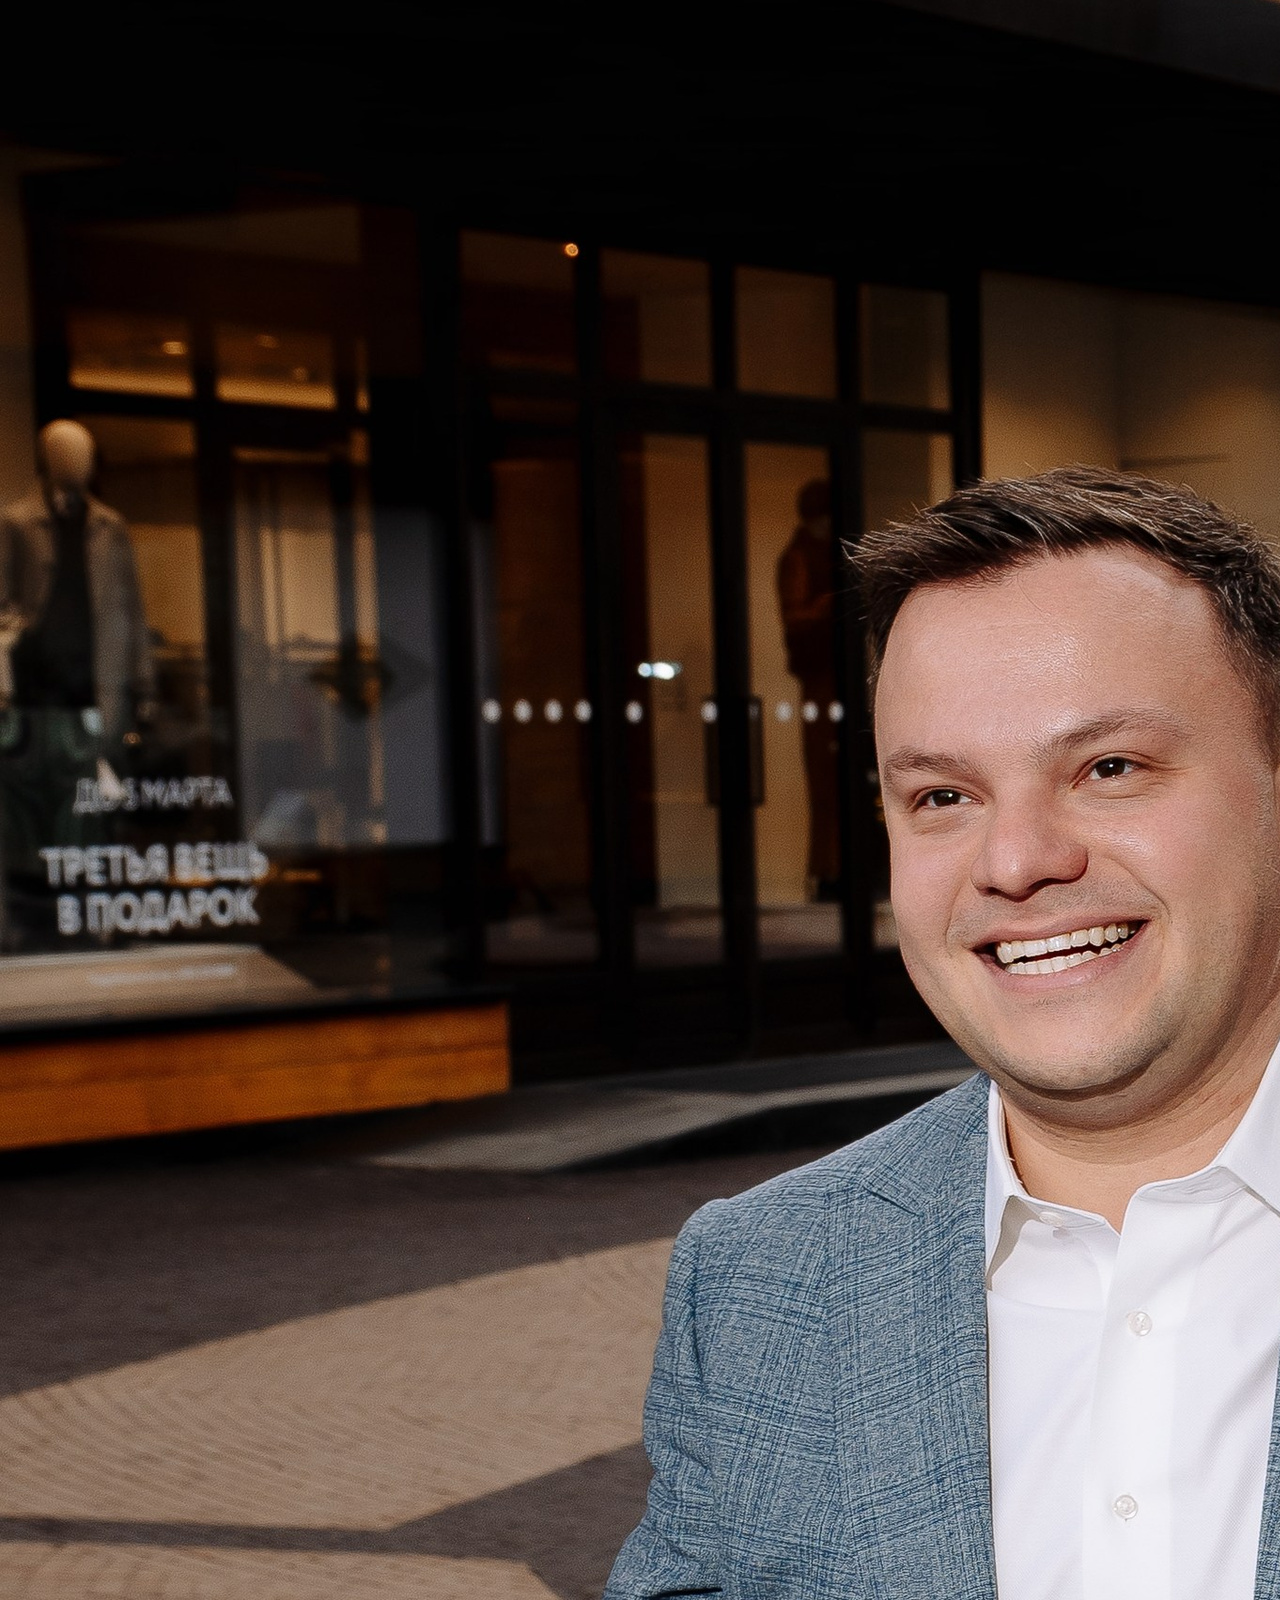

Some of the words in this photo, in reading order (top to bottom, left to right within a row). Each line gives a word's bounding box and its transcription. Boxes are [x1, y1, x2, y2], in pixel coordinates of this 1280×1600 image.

[140, 775, 234, 808] МАРТА
[39, 842, 169, 888] ТРЕТЬЯ
[173, 841, 269, 882] ВЕЩЬ
[57, 893, 82, 935] В
[86, 886, 260, 935] ПОДАРОК
